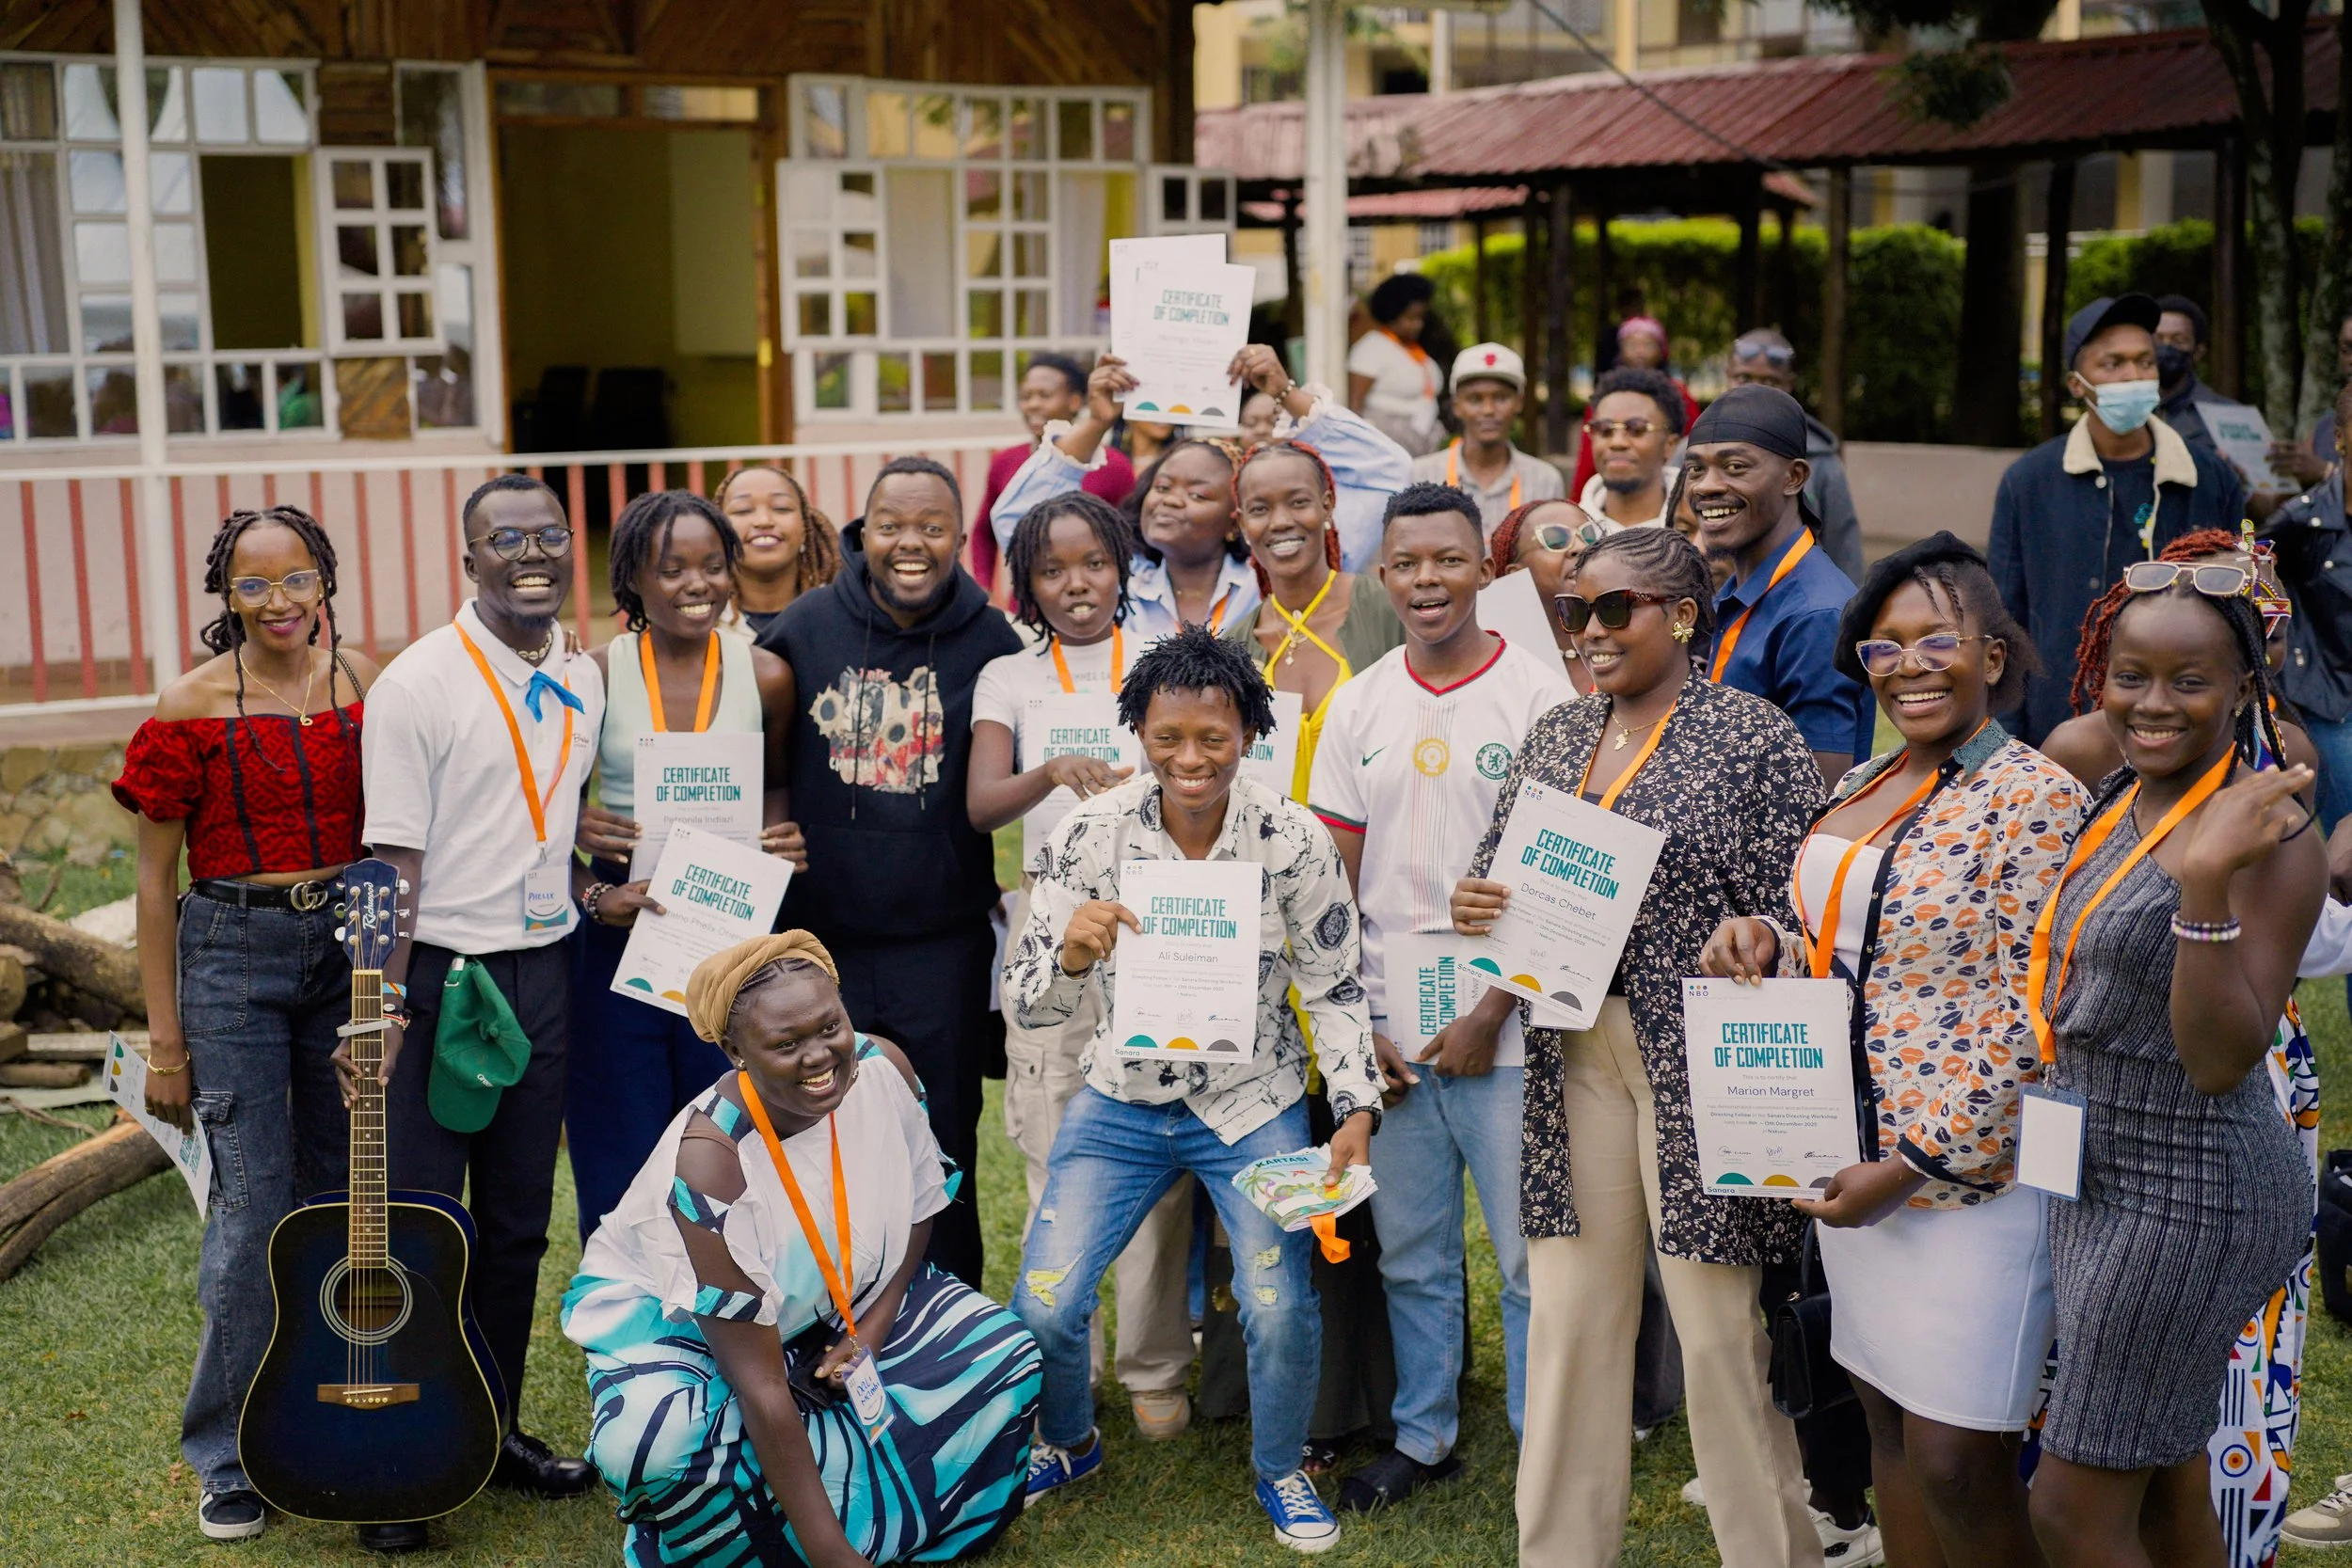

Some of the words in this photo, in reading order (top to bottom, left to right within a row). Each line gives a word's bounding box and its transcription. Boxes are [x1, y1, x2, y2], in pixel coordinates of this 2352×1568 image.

[1163, 290, 1223, 309] CERTIFICATE
[1153, 307, 1167, 320] OF
[1168, 308, 1230, 325] COMPLETION
[1050, 728, 1111, 745] CERTIFICATE
[1044, 747, 1056, 762] OF
[663, 768, 730, 783] CERTIFICATE
[657, 786, 670, 801] OF
[674, 786, 740, 801] COMPLETION
[1536, 828, 1616, 875] CERTIFICATE
[685, 863, 753, 901] CERTIFICATE
[1520, 846, 1539, 867] OF
[1540, 853, 1619, 900] COMPLETION
[363, 881, 376, 929] Richwood
[672, 879, 688, 897] OF
[688, 886, 755, 922] COMPLETION
[1152, 896, 1226, 917] CERTIFICATE
[1520, 882, 1557, 904] Dorcas
[1557, 897, 1597, 920] Chebet
[666, 909, 690, 923] tieno
[1142, 916, 1157, 934] OF
[1161, 918, 1236, 939] COMPLETION
[1159, 952, 1170, 960] Ali
[1174, 952, 1218, 963] Suleiman
[1458, 963, 1483, 978] Sanara
[1419, 967, 1437, 1035] CERTIFICATE
[1438, 957, 1456, 1027] COMPLETION
[1722, 1022, 1808, 1044] CERTIFICATE
[1714, 1048, 1732, 1067] OF
[1737, 1048, 1823, 1069] COMPLETION
[1727, 1085, 1767, 1097] Marion
[1771, 1086, 1814, 1099] Margret
[1255, 1157, 1309, 1168] KARTASI
